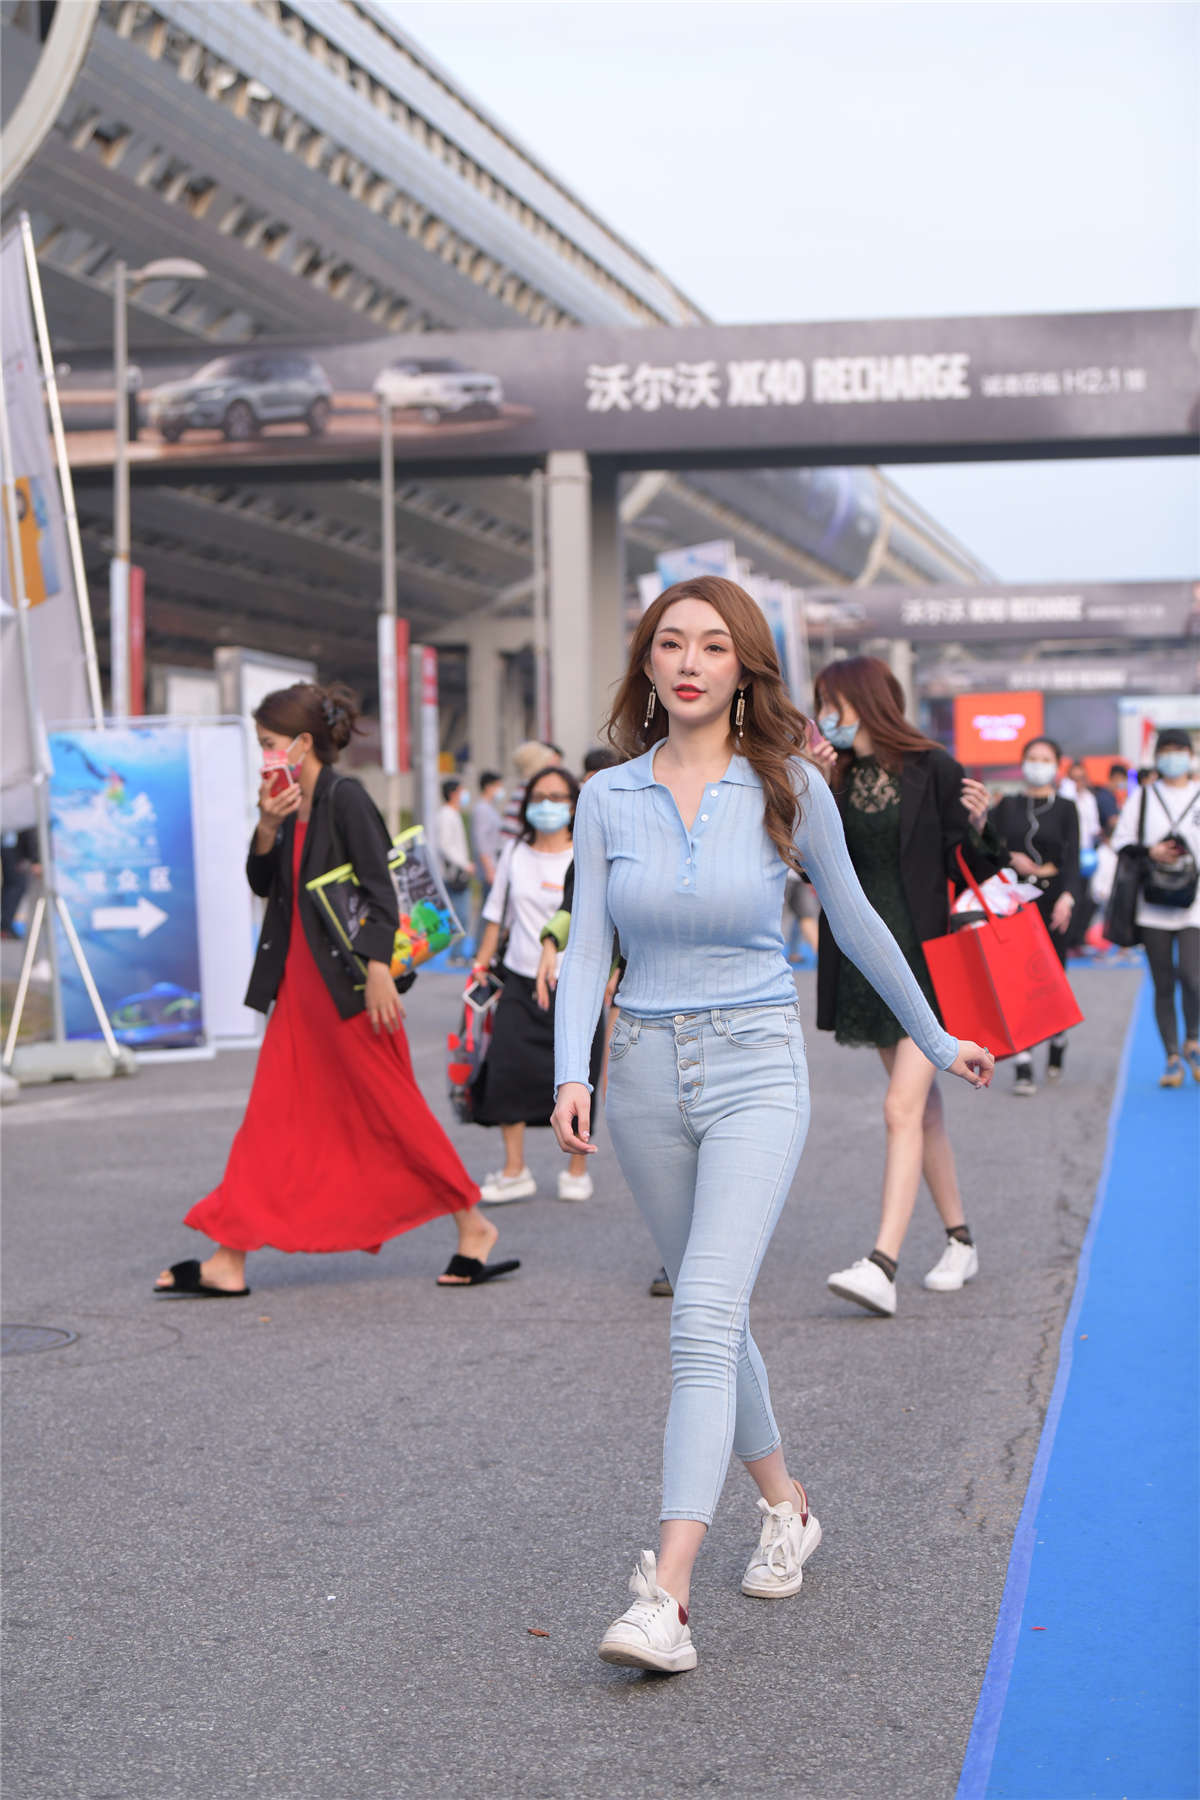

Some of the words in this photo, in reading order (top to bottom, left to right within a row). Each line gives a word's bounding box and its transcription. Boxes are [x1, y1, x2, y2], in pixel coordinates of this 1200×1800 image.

[585, 361, 719, 410] 沃尔沃
[727, 359, 805, 406] XC40
[813, 353, 970, 404] RECHARGE
